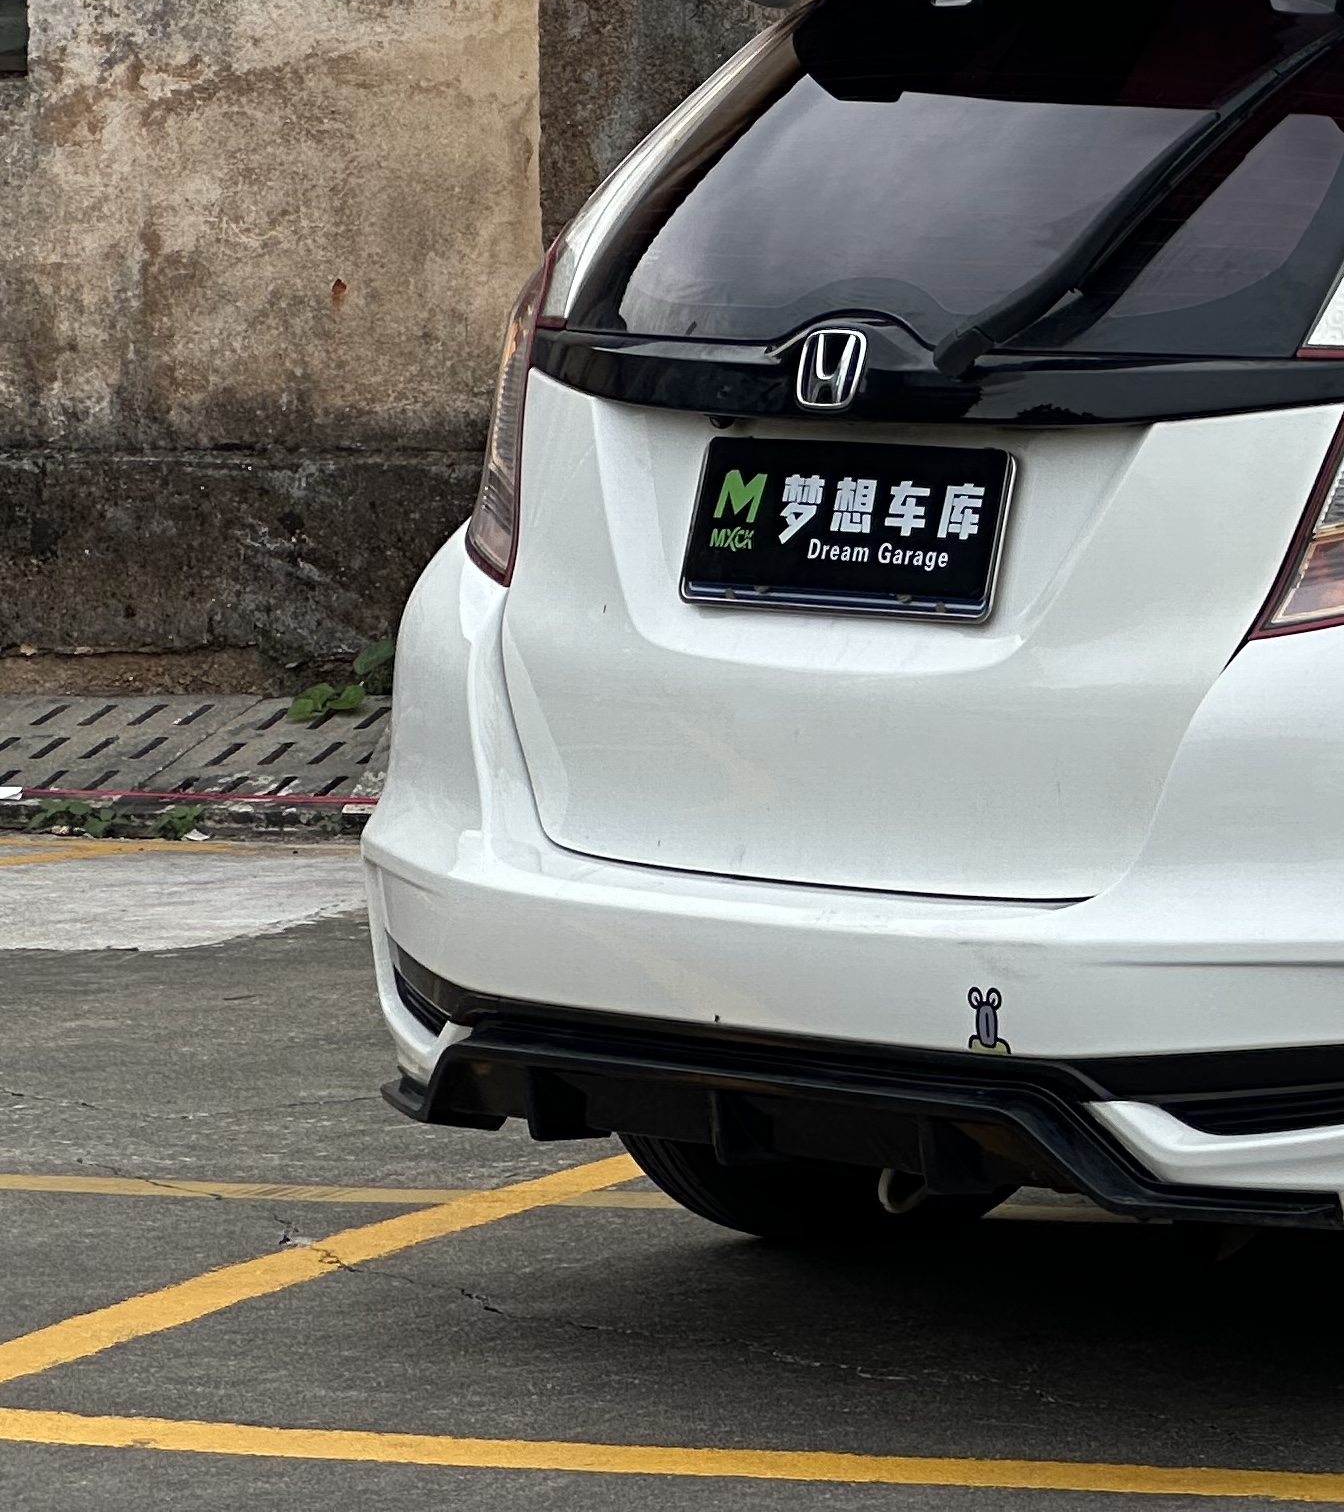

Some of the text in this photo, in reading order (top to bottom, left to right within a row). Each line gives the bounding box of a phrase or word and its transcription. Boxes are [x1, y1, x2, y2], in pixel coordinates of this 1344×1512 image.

[779, 474, 986, 544] 梦想车库
[807, 538, 949, 572] Dream Garage
